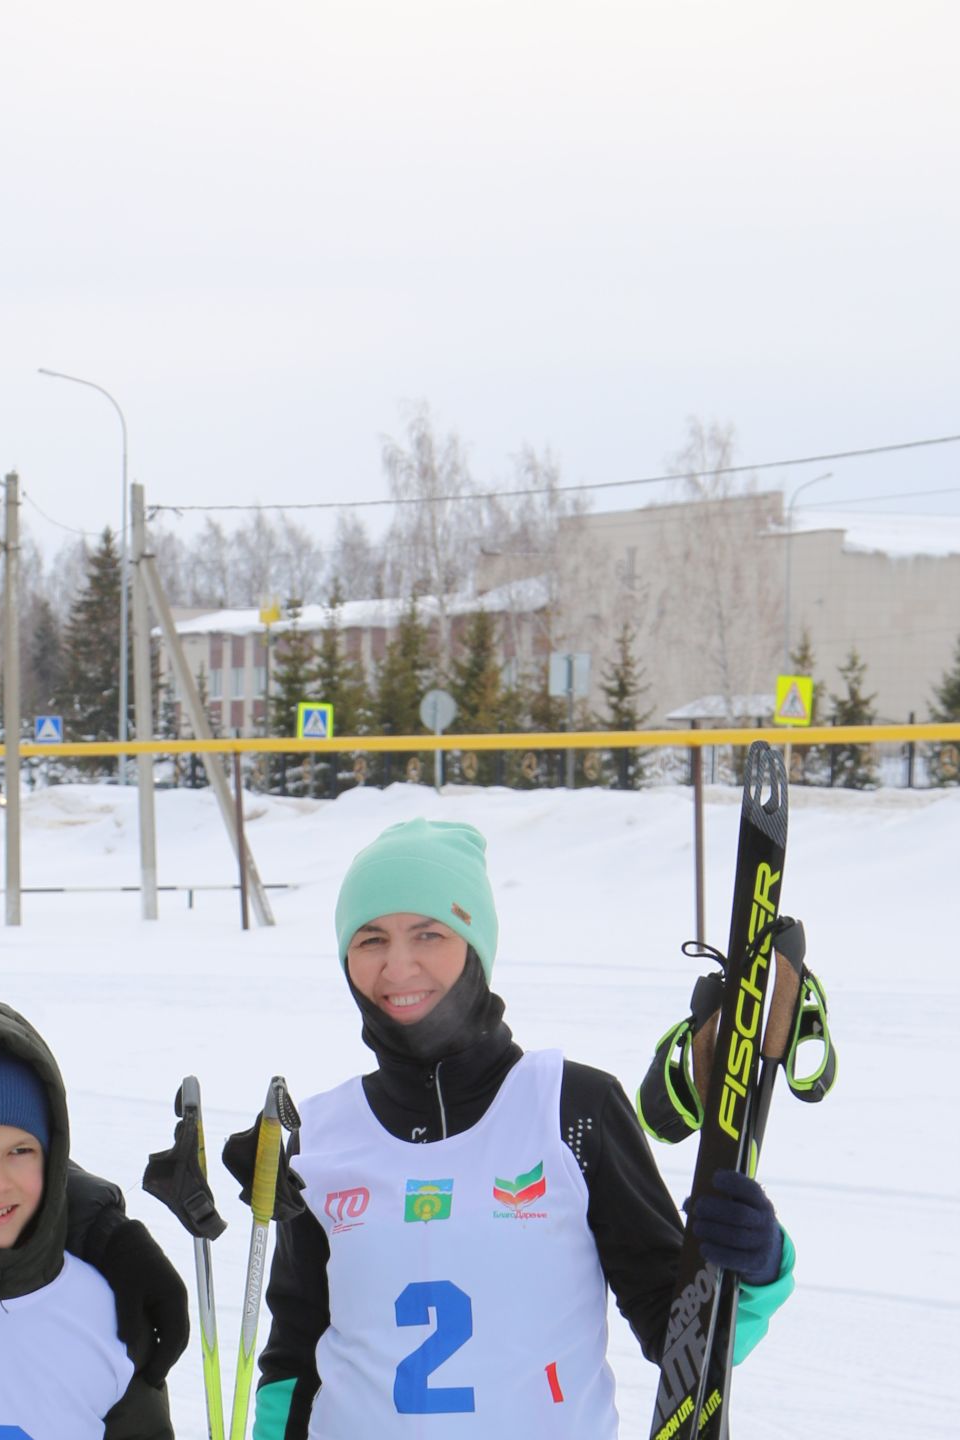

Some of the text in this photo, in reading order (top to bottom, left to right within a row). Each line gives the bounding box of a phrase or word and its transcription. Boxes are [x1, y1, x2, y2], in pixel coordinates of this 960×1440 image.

[718, 862, 780, 1141] FISCHER
[246, 1227, 265, 1317] GERMINA
[394, 1280, 475, 1414] 2
[676, 1395, 696, 1427] LITE
[706, 1388, 722, 1421] LITE
